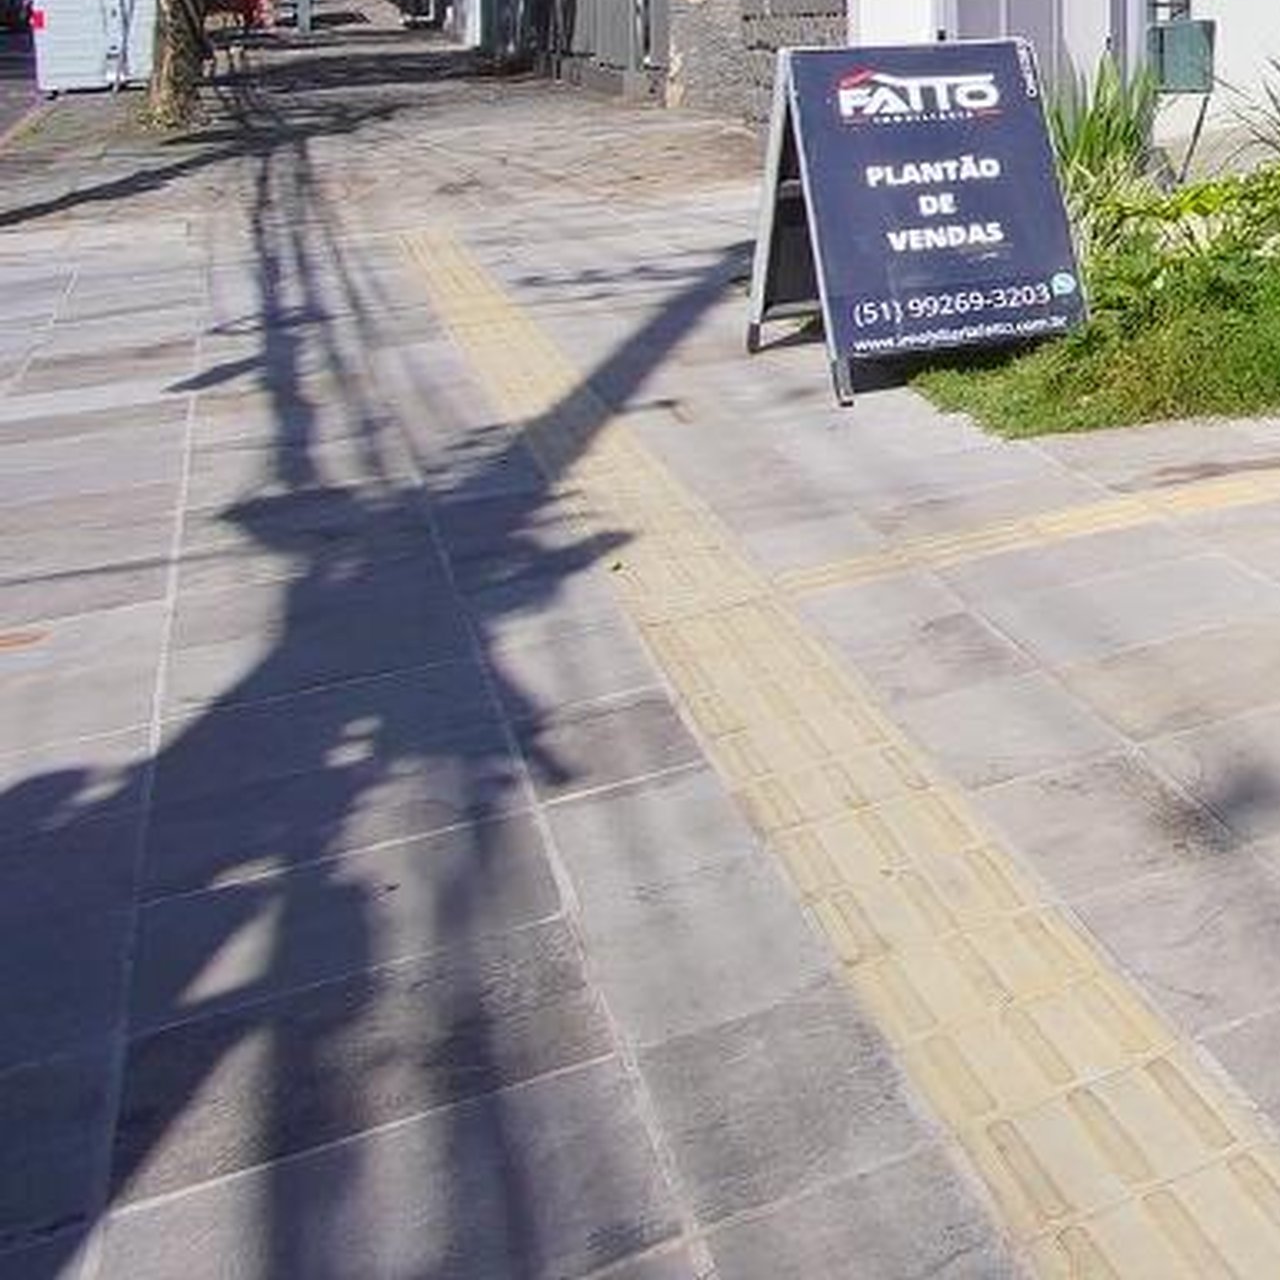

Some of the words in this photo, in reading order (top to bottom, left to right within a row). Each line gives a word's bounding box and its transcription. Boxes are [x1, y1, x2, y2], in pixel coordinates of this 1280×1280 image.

[837, 72, 1001, 118] FATTO
[865, 154, 1001, 188] PLANTÃO
[918, 194, 957, 217] DE
[887, 221, 1004, 252] VENDAS
[853, 301, 903, 327] (51)
[908, 282, 1052, 320] 99269-3203
